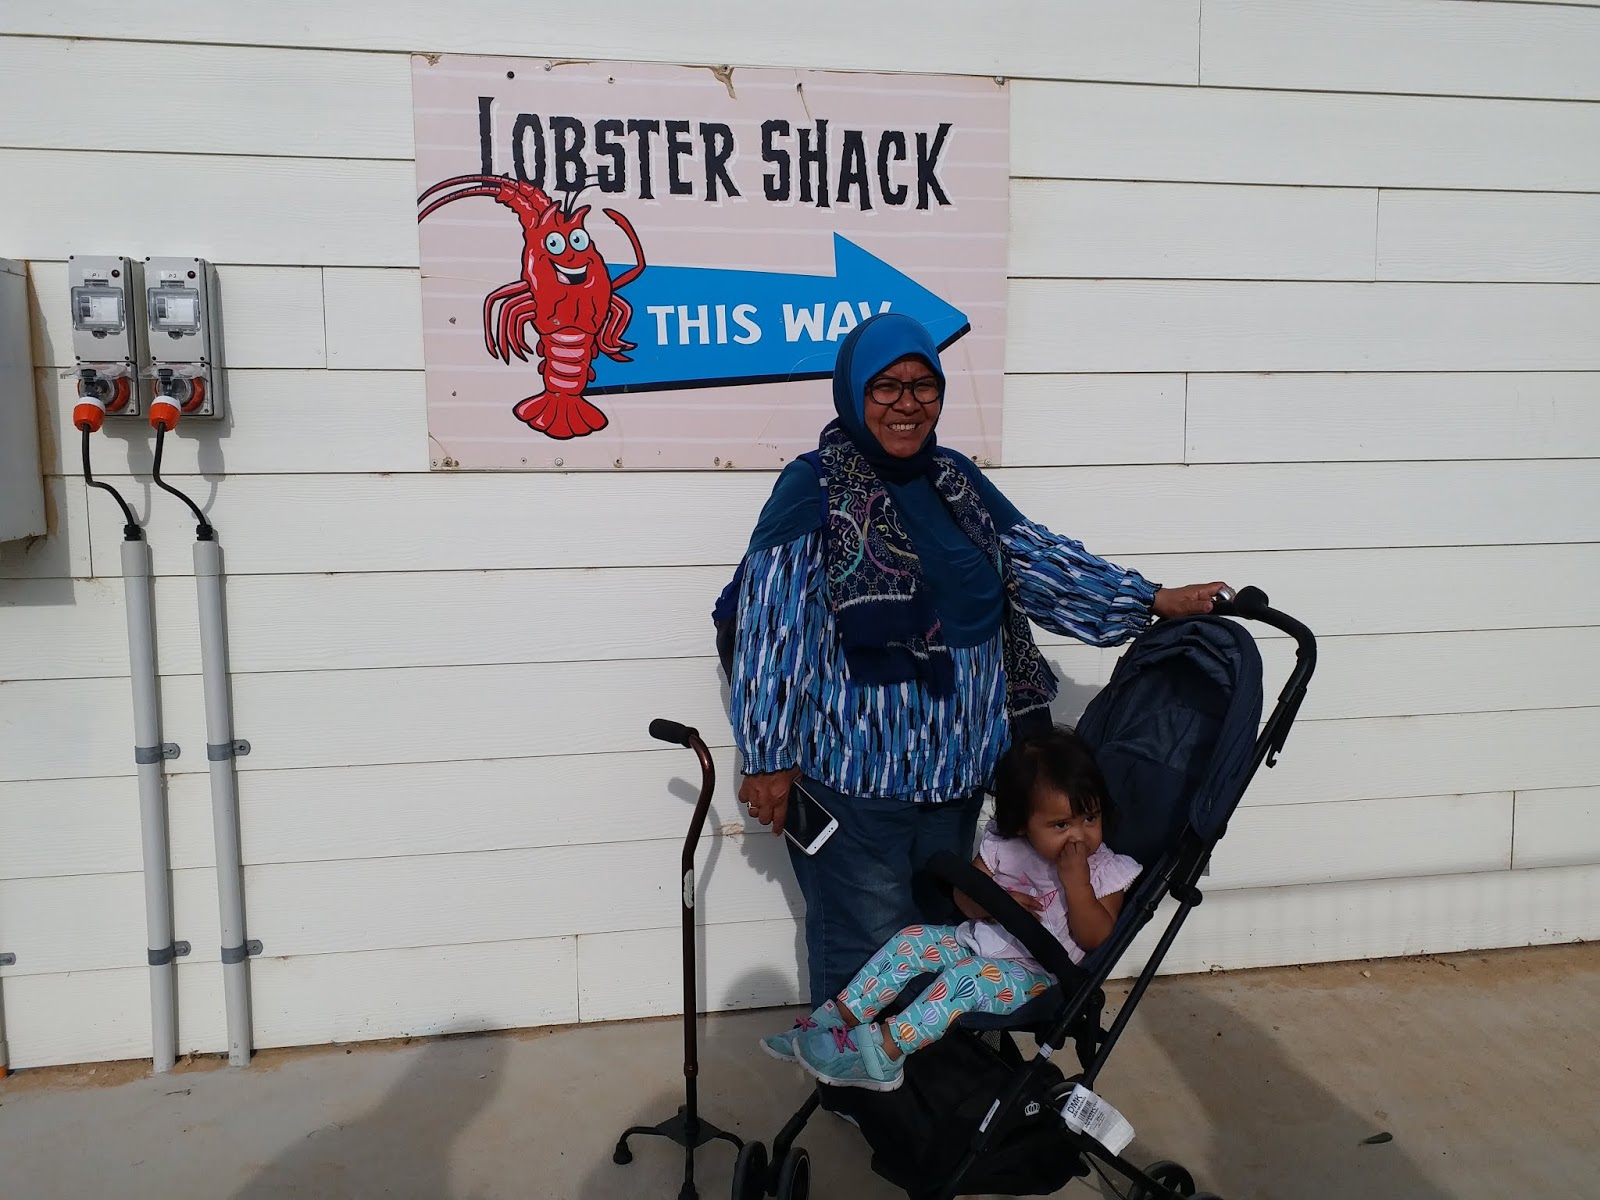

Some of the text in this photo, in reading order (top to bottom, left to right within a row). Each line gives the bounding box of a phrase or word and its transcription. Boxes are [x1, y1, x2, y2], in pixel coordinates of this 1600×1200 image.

[478, 96, 953, 212] LOBSTER SHACK
[647, 304, 762, 345] THIS
